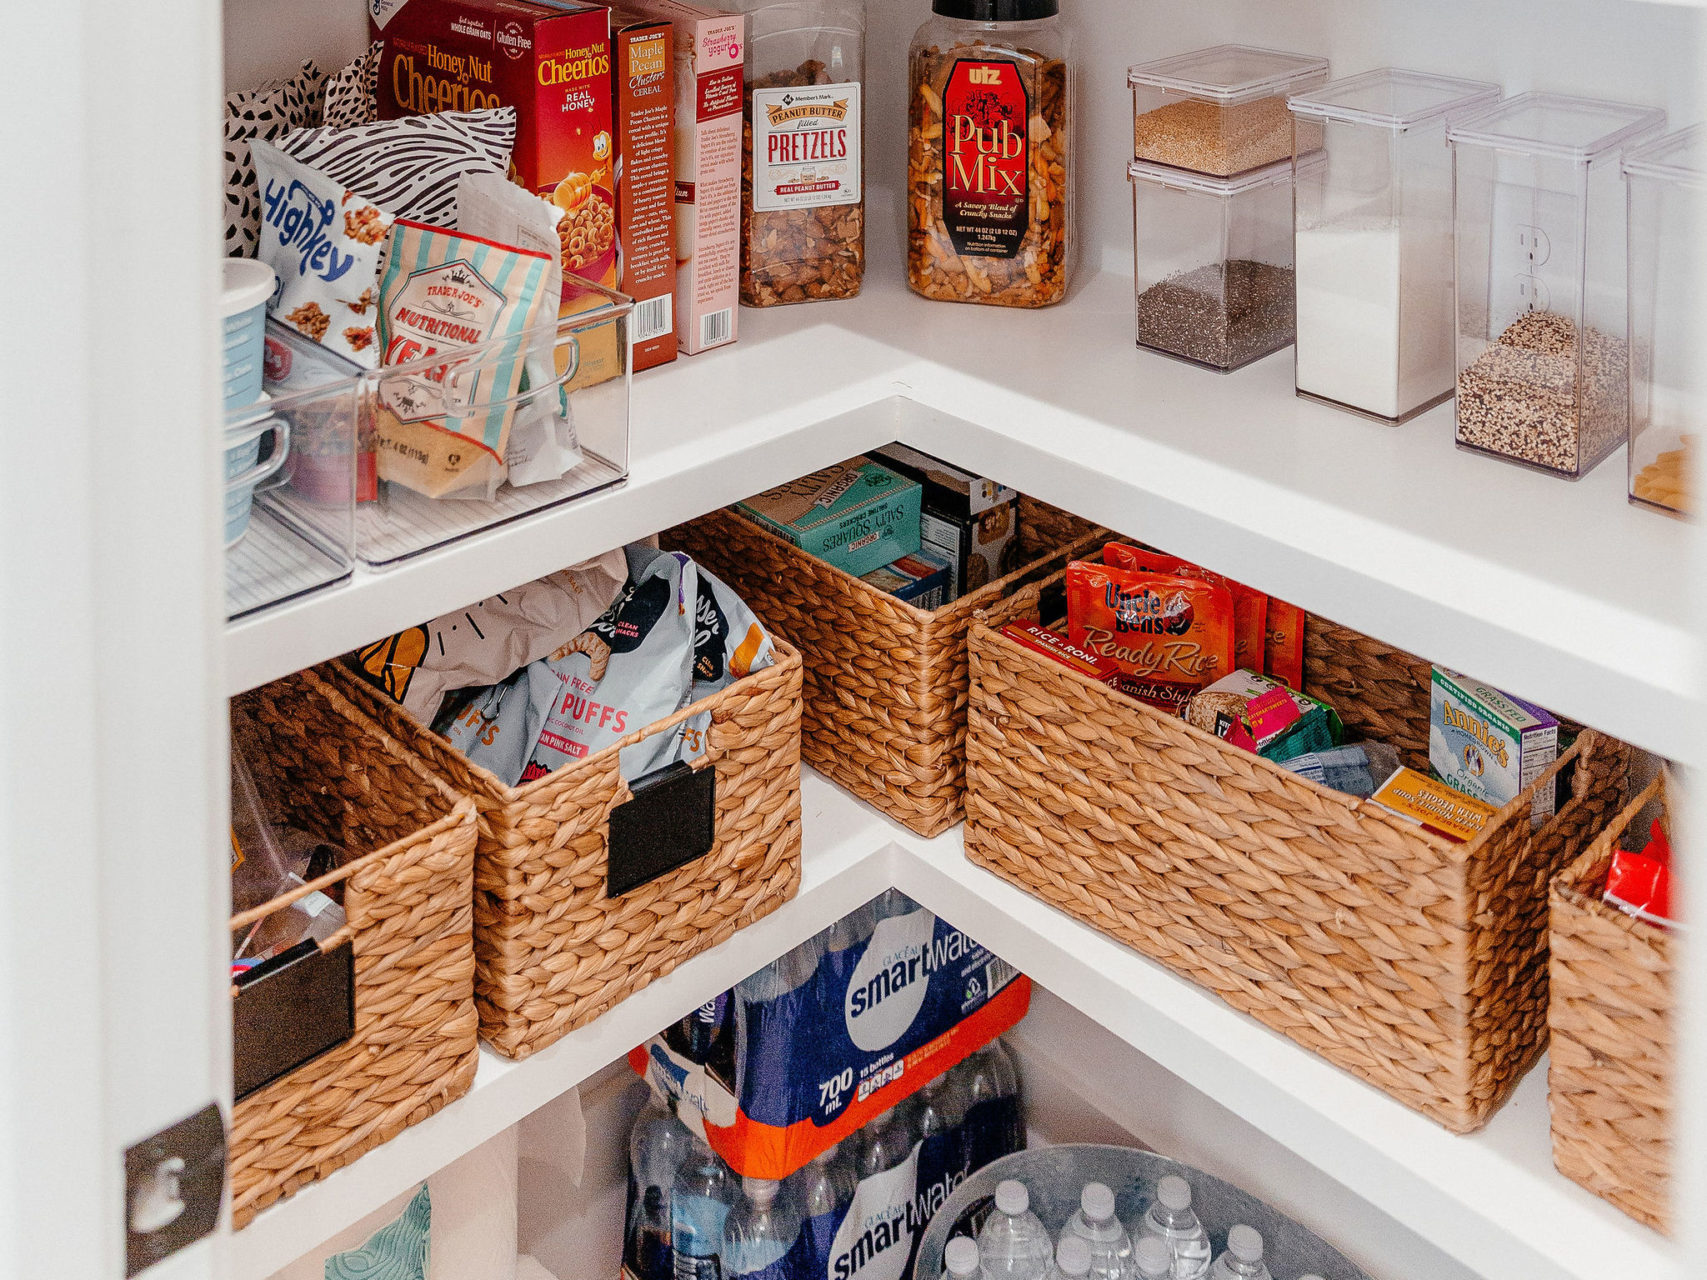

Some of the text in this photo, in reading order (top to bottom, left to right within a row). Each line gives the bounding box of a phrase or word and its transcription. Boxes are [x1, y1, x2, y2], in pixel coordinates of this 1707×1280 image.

[451, 23, 492, 41] WHOLE GRAIN OATS
[496, 31, 532, 49] Gluten Free
[630, 35, 648, 43] TRADER
[702, 33, 737, 48] Strawberry
[565, 47, 590, 59] Honey
[591, 42, 605, 54] Nut
[630, 42, 664, 60] Maple
[708, 41, 730, 58] yogurt
[427, 44, 465, 81] Honey
[468, 55, 493, 84] Nut
[537, 55, 610, 86] Cheerios
[631, 59, 663, 74] Pecan
[393, 54, 500, 113] Cheerios
[629, 70, 665, 89] Clusters
[566, 90, 591, 103] REAL
[633, 84, 662, 98] CEREAL
[561, 97, 595, 113] HONEY
[772, 107, 843, 123] PEANUT BUTTER
[796, 119, 819, 130] filled
[768, 129, 847, 163] PRETZELS
[952, 114, 1023, 160] Pub
[949, 153, 1024, 196] Mix
[779, 182, 836, 194] REAL PEANUT BUTTER
[960, 209, 1012, 219] Crunchy Snacks
[963, 202, 987, 212] Savory
[988, 203, 1009, 211] Blend
[1009, 203, 1017, 213] of
[956, 225, 965, 233] NET
[427, 286, 482, 309] TRADER JOE'S
[395, 307, 483, 344] NUTRITIONAL
[819, 471, 860, 504] ORGANIC
[822, 504, 904, 553] SALTY SQUARES
[851, 532, 877, 551] ORGANIC
[1104, 581, 1161, 615] Uncle
[617, 621, 638, 631] CLEAN
[1026, 626, 1057, 646] RICE
[1034, 639, 1072, 660] SPANISH RICE
[1083, 625, 1219, 678] Ready Rice
[571, 677, 595, 696] FREE
[560, 692, 629, 734] PUFFS
[1440, 678, 1511, 733] CERTIFIED ORGANIC
[1476, 686, 1527, 723] GRASS FED
[1443, 699, 1510, 768] Annie's
[1523, 729, 1557, 740] Nutrition Facts
[549, 737, 583, 756] PINK SALT
[1456, 768, 1490, 798] Organic
[1392, 787, 1416, 803] SOUP
[1418, 789, 1455, 813] VEGGIES
[1418, 799, 1454, 820] NOODLE
[1457, 807, 1483, 823] WITH
[882, 945, 922, 968] GLACÉAU
[860, 1052, 895, 1078] 15 bottles
[818, 1066, 853, 1108] 700
[825, 1095, 842, 1117] mL
